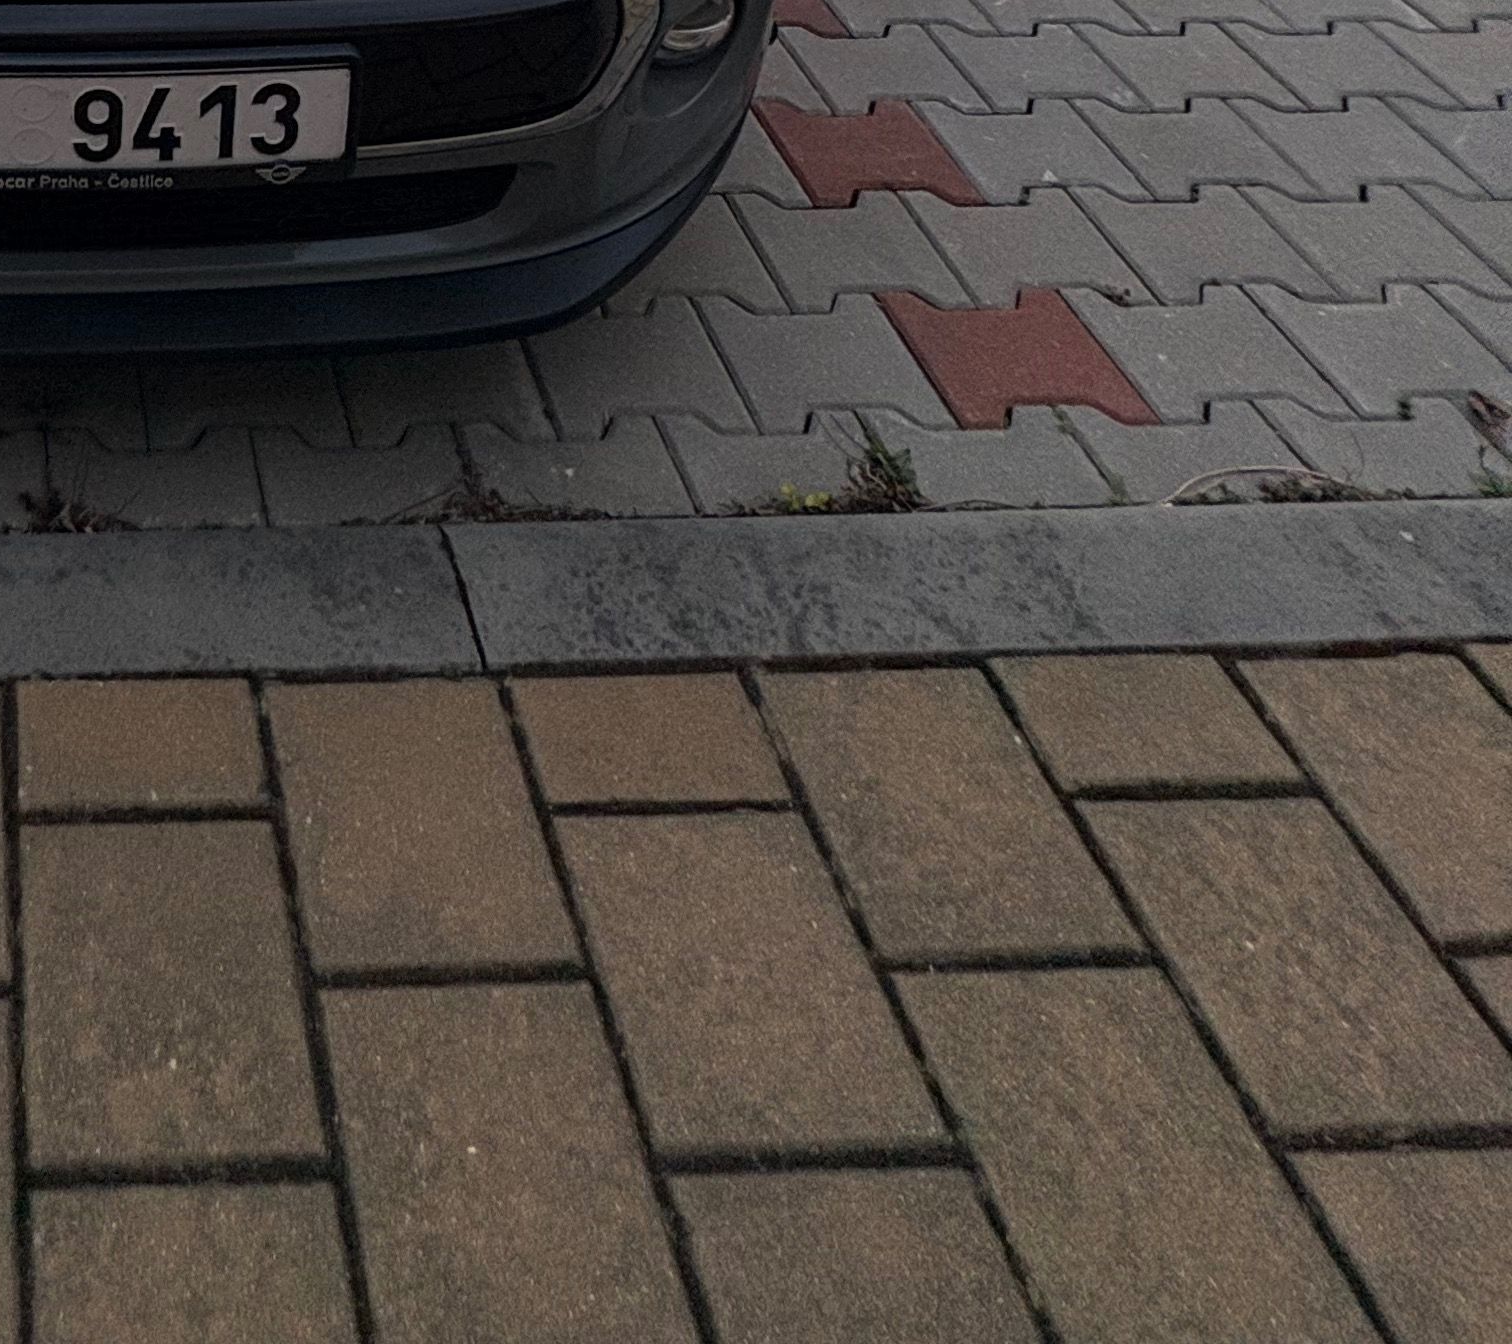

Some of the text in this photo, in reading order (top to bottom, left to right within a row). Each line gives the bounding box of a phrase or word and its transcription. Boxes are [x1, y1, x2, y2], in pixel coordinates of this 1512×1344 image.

[72, 82, 302, 163] 9413
[39, 174, 89, 189] Praha
[107, 172, 174, 189] Čestlice
